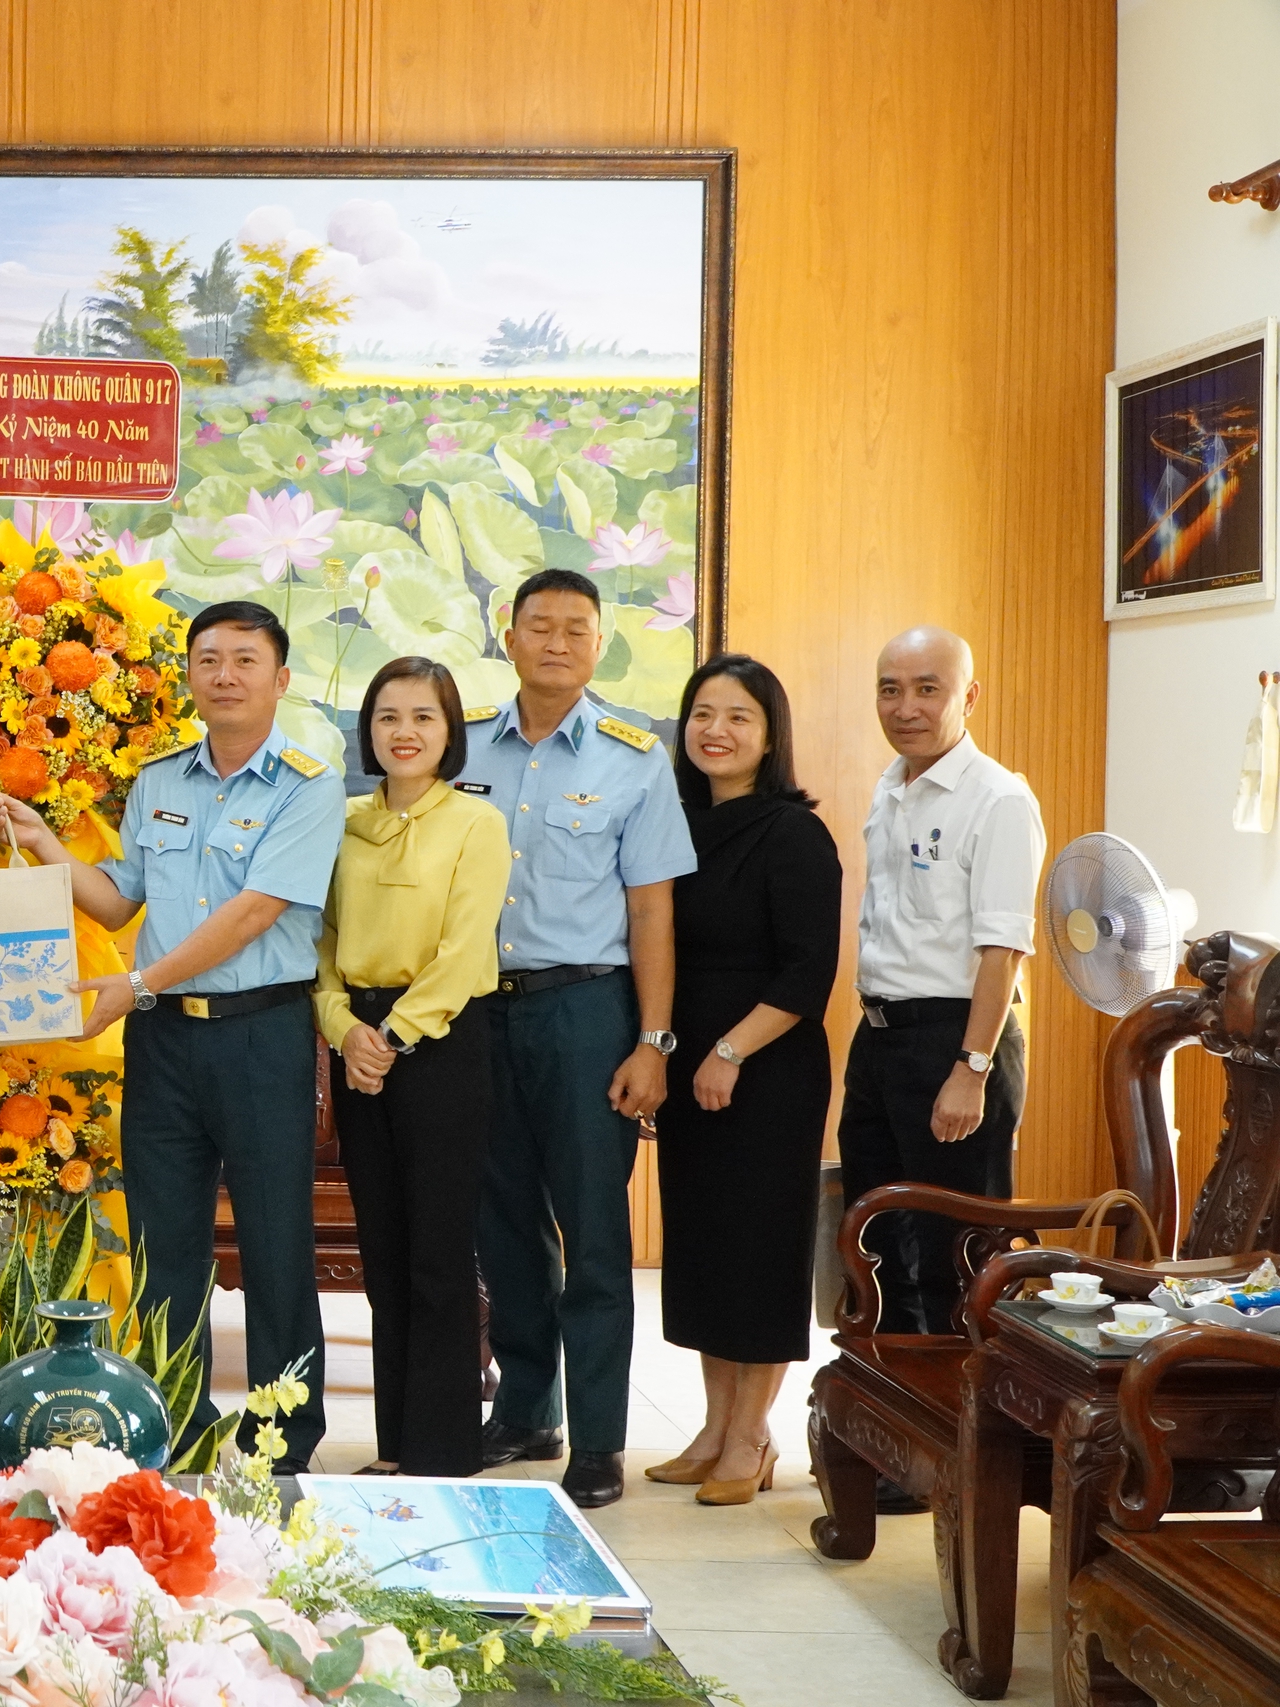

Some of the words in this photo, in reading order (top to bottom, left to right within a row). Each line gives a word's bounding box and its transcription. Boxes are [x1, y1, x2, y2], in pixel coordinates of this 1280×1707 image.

[12, 369, 50, 400] ĐOÀN
[53, 370, 101, 402] KHÔNG
[105, 372, 142, 405] QUÂN
[145, 378, 172, 405] 917
[21, 415, 71, 444] Niệm
[76, 419, 99, 440] 40
[103, 418, 150, 444] Năm
[14, 453, 50, 481] HÀNH
[54, 452, 74, 481] SỐ
[75, 456, 102, 483] BÁO
[106, 454, 132, 484] ĐẦU
[136, 458, 169, 485] TIÊN
